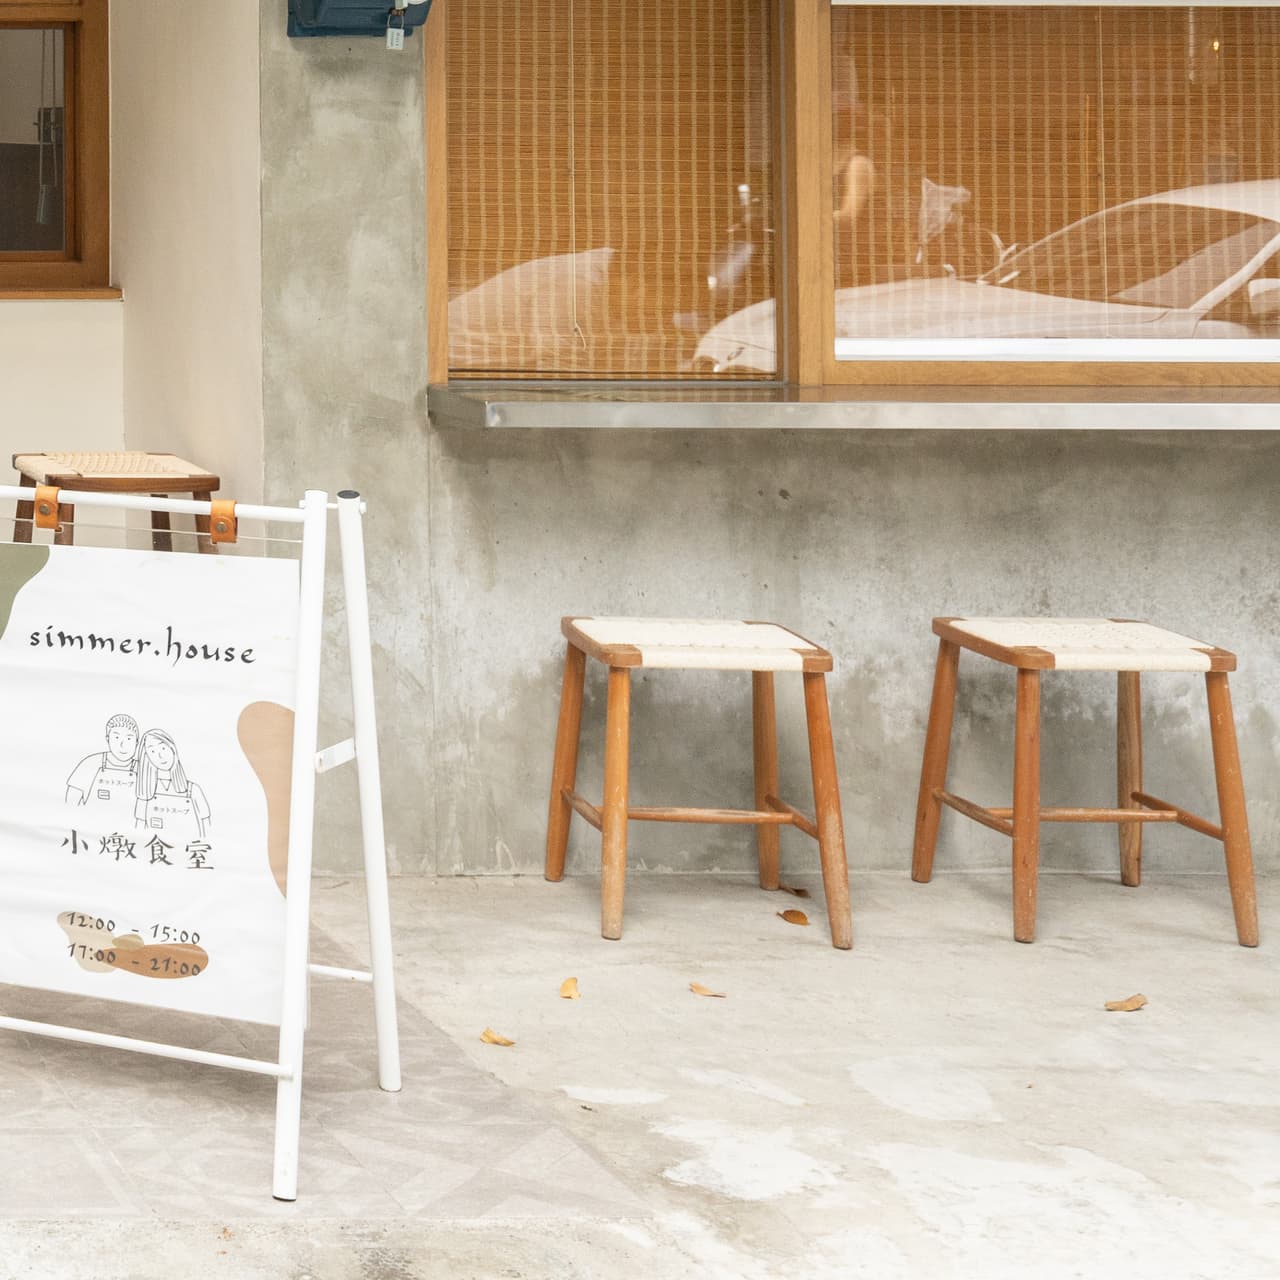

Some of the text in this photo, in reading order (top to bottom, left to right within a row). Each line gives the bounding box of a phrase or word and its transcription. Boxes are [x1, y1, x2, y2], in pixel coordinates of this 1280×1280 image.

[29, 625, 257, 665] simmer.house
[60, 829, 214, 870] 小燉食室
[66, 911, 116, 931] 12:00
[150, 923, 201, 944] 15:00
[67, 942, 117, 963] 17:00
[150, 956, 201, 977] 21:00
